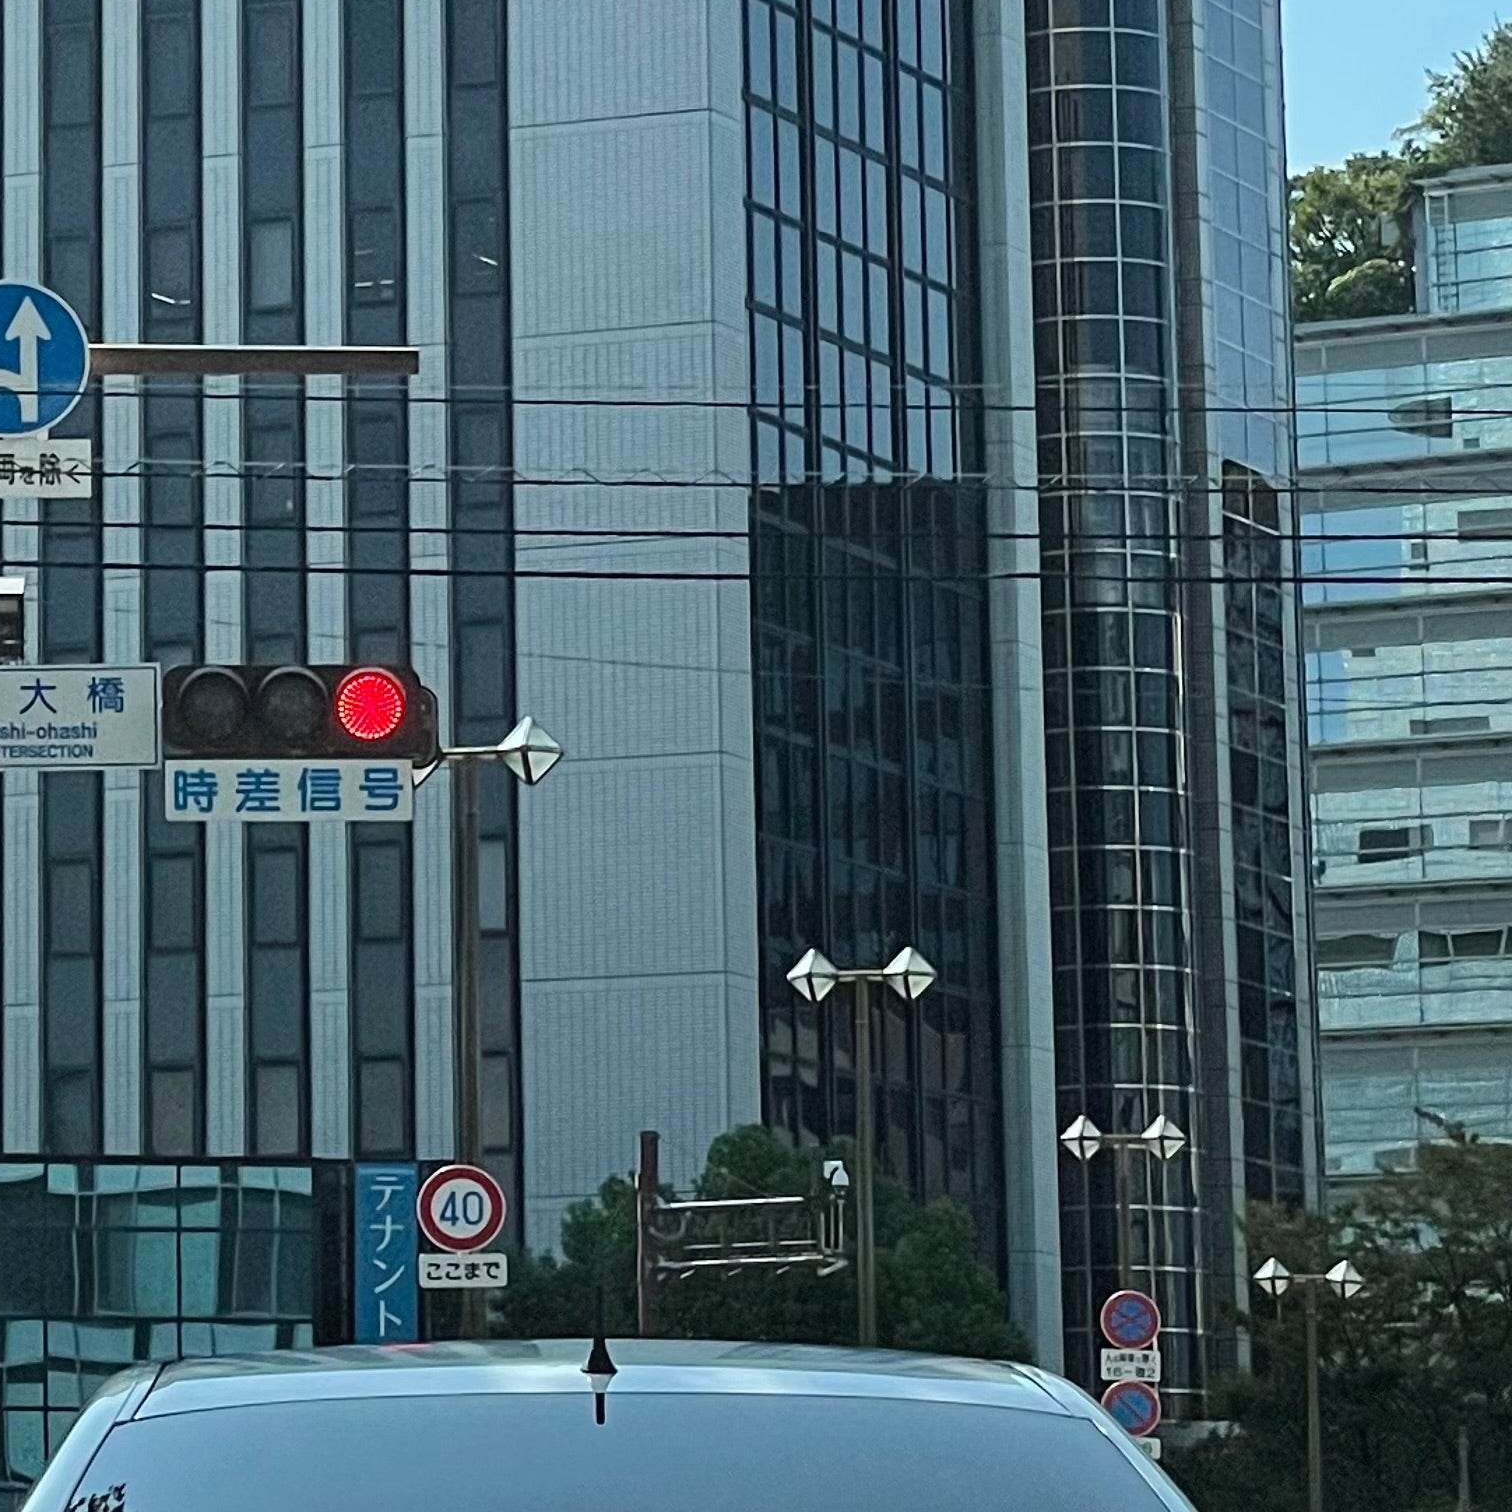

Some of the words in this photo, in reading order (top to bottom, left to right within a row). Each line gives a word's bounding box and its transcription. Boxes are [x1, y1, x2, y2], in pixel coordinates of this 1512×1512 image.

[173, 767, 404, 813] 時差信号
[439, 1190, 485, 1227] 40
[369, 1175, 406, 1337] テナント
[426, 1261, 501, 1281] ここまで
